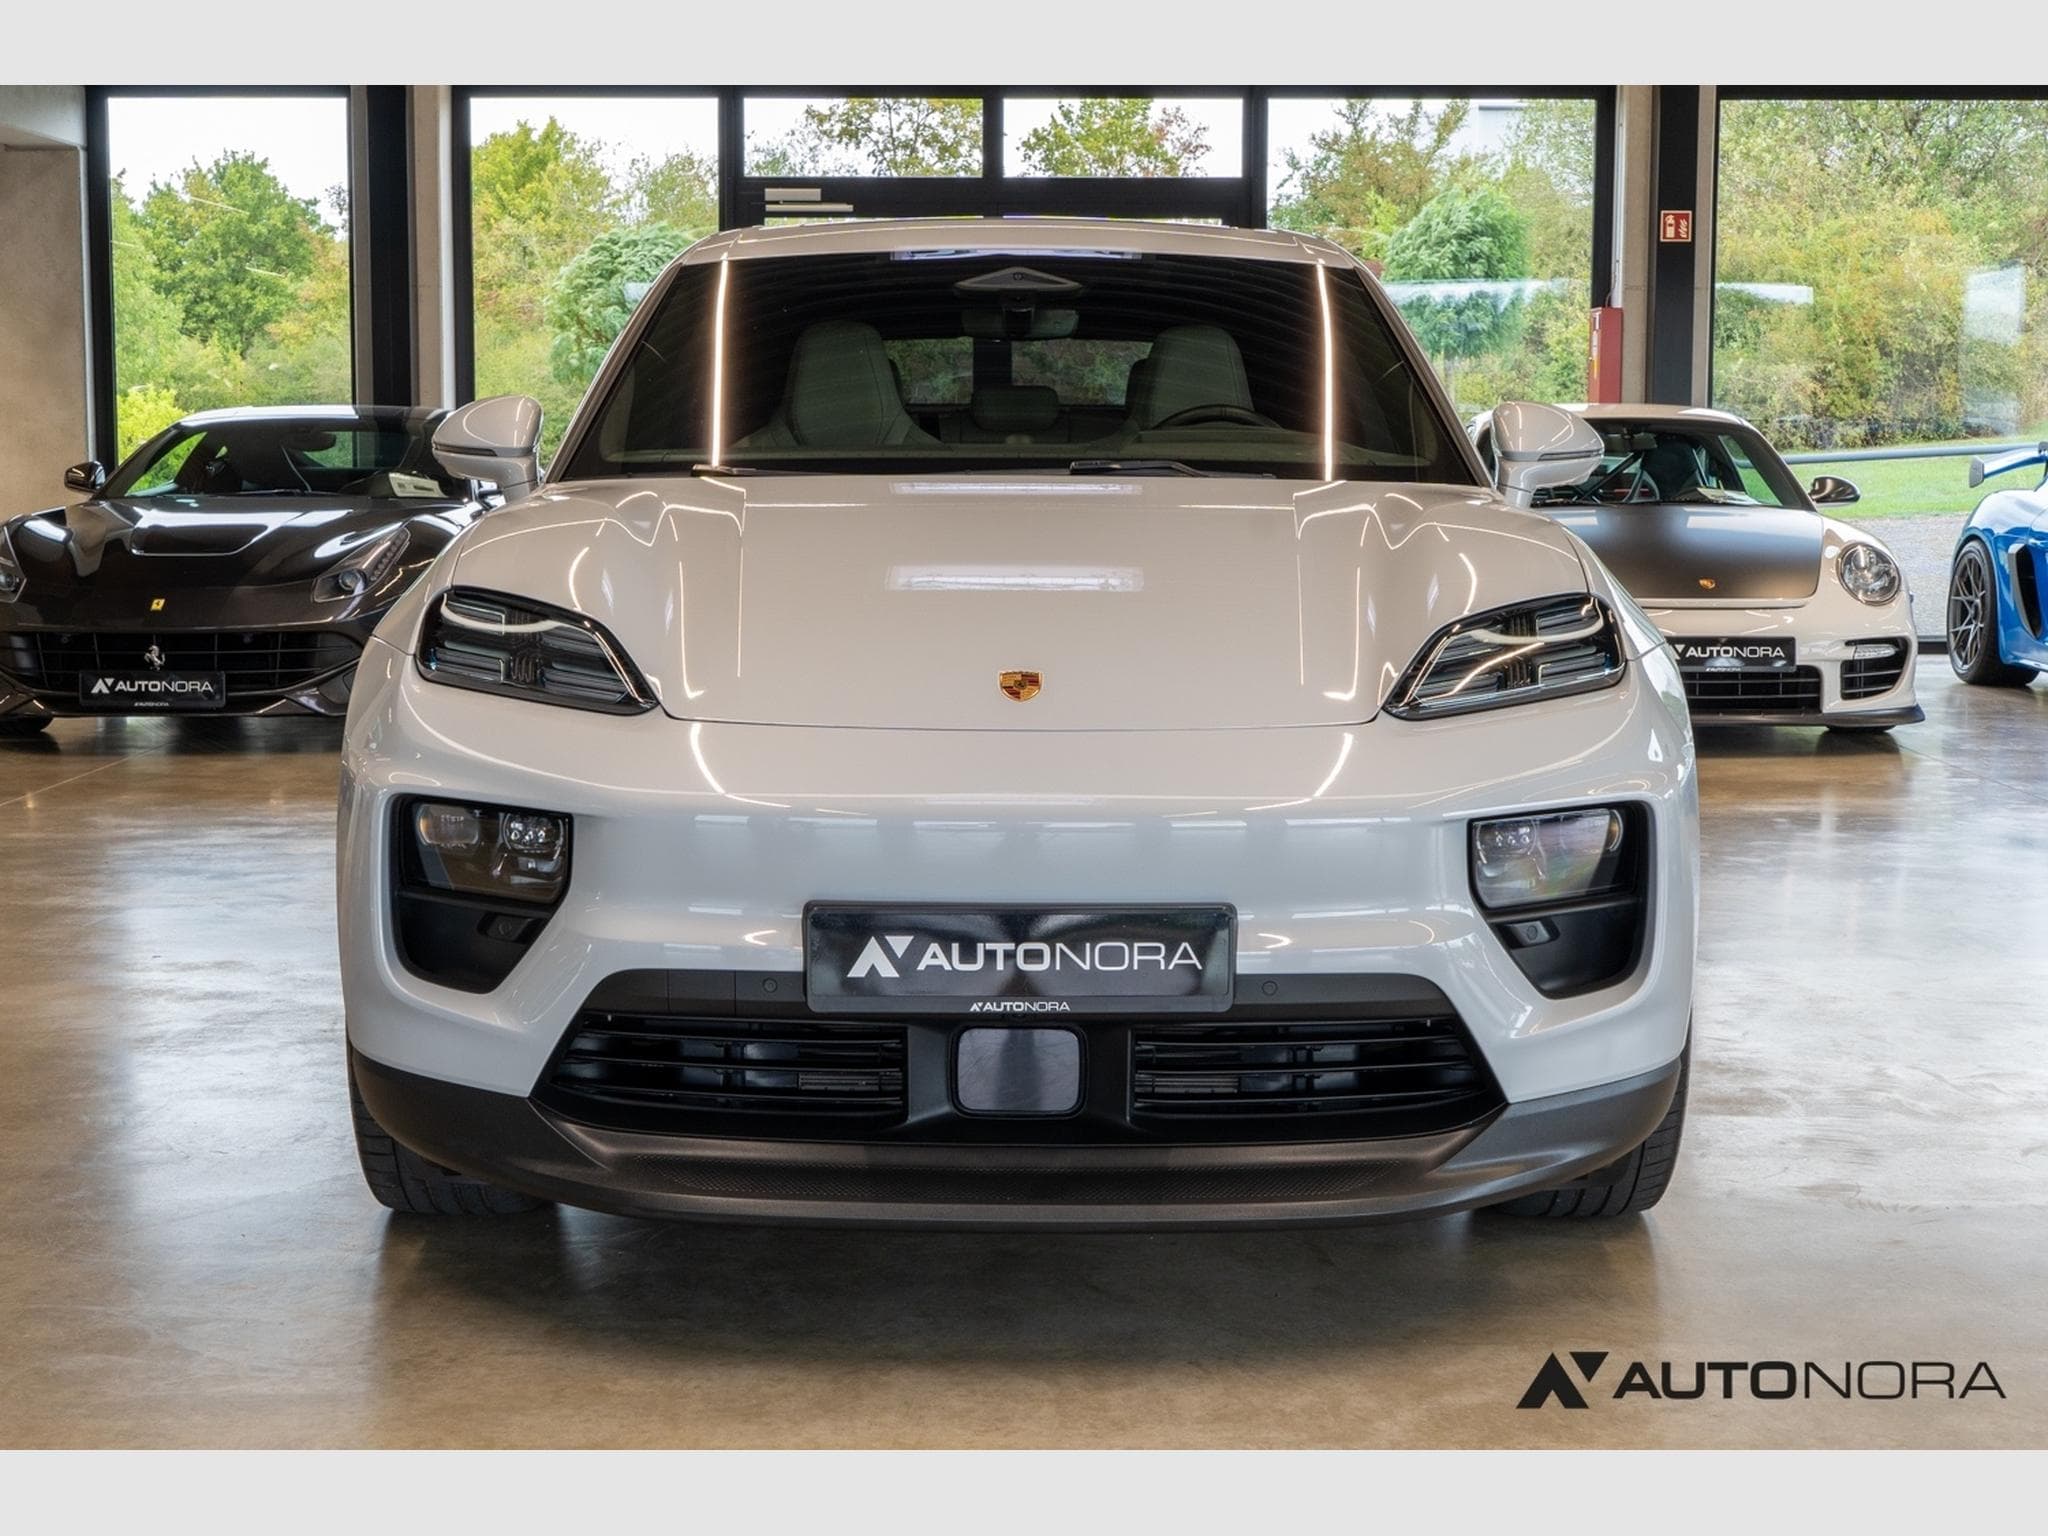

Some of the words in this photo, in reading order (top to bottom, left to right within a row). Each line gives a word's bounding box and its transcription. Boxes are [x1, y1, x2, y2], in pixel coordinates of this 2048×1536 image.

[1686, 646, 1785, 658] AUTONORA
[114, 681, 214, 694] AUTONORA
[916, 941, 1203, 971] AUTONORA
[982, 1001, 1071, 1012] AUTONORA
